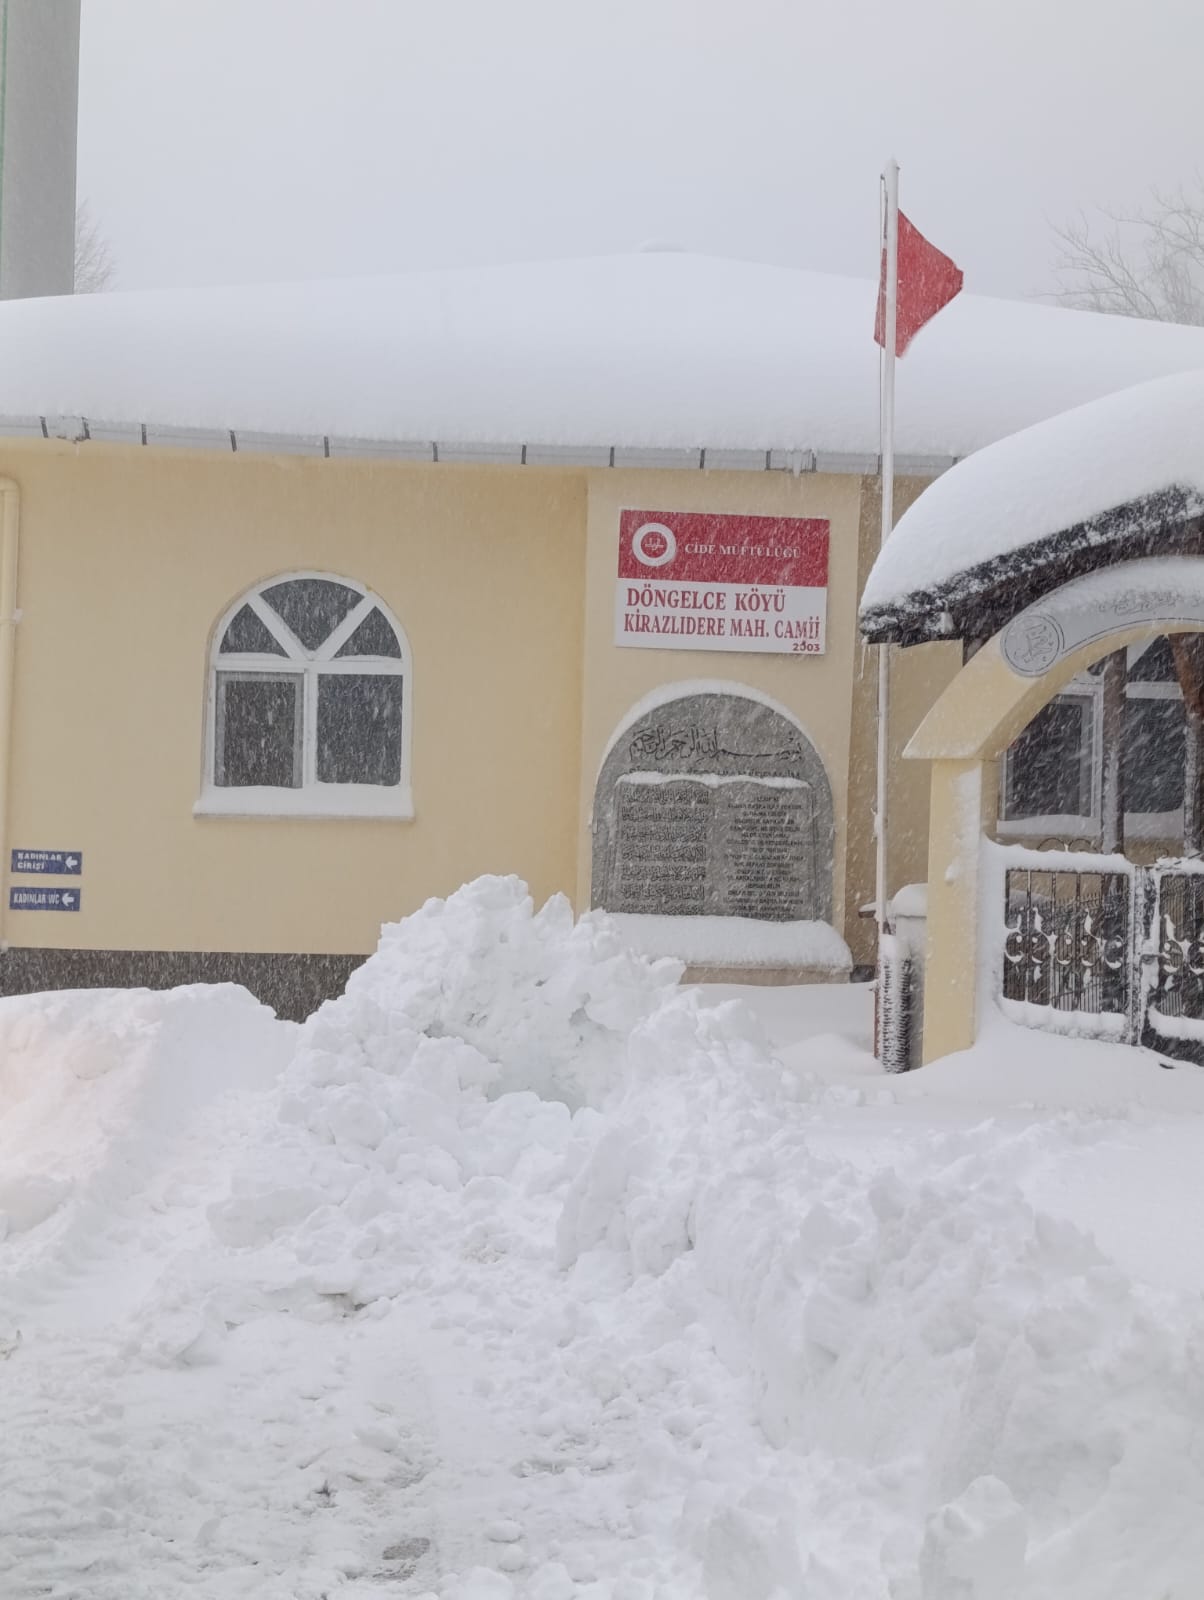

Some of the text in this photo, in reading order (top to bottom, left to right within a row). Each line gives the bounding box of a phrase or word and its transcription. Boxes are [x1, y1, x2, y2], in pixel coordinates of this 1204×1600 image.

[685, 541, 716, 555] CİDE
[627, 584, 785, 612] DÖNGELCE KÖYÜ
[624, 609, 820, 639] KİRAZLIDERE MAH. CAMİİ
[792, 641, 820, 652] 2003
[13, 893, 60, 904] KADINLAR WC
